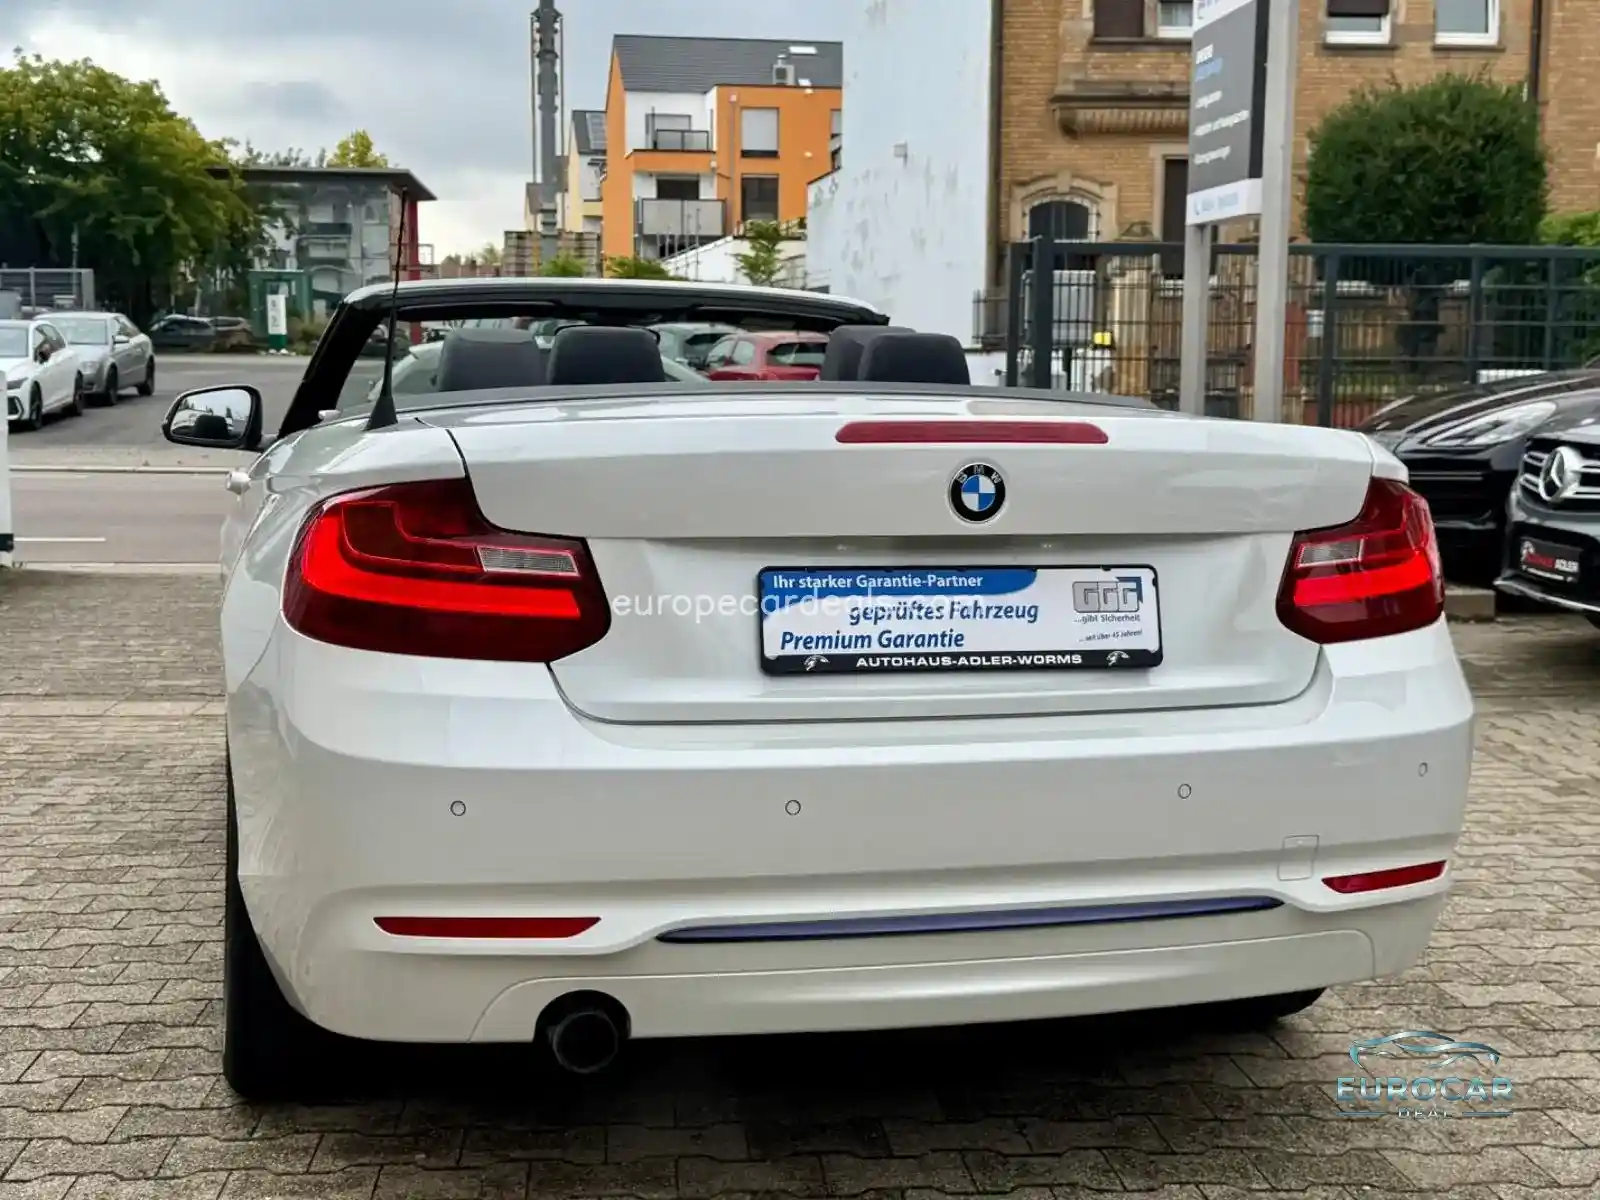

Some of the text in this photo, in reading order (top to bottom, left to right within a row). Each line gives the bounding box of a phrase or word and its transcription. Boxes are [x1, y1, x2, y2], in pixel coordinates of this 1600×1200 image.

[773, 574, 984, 589] Ihr starker Garantie-Partner
[849, 599, 1039, 626] geprüftes Fahrzeug
[1100, 613, 1140, 623] Sicherheit
[781, 628, 964, 650] Premium Garantie
[856, 654, 1082, 667] AUTOHAUS-ADLER-WORMS
